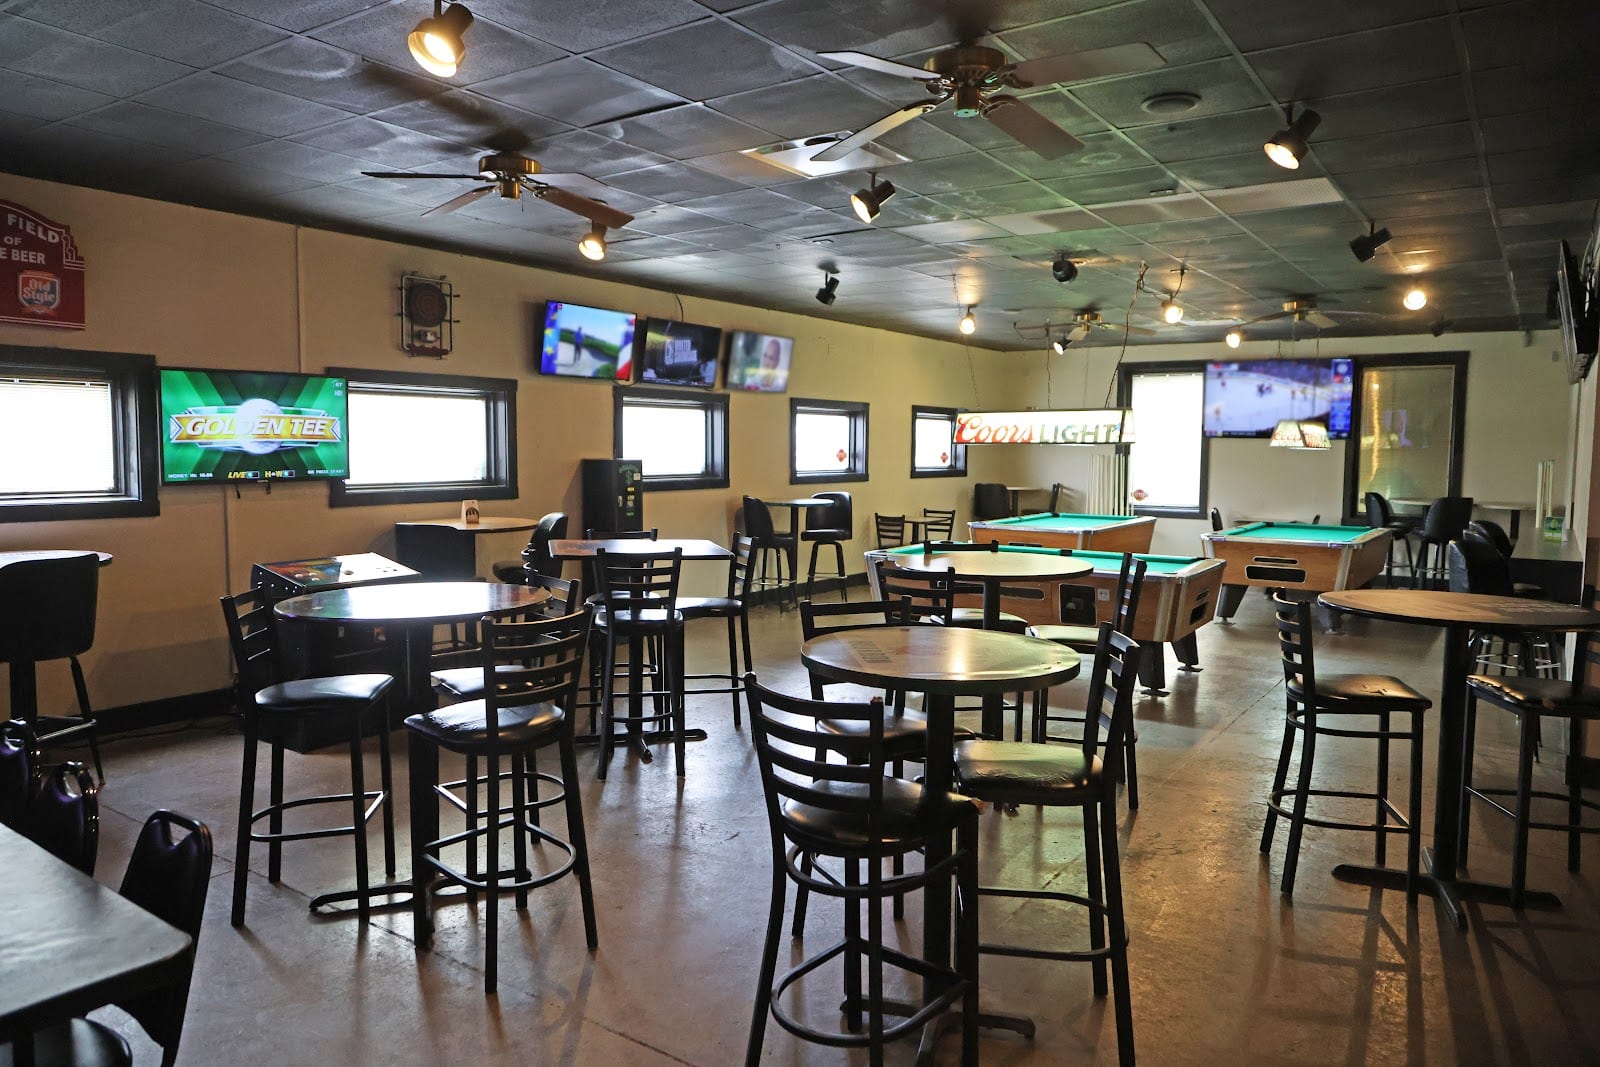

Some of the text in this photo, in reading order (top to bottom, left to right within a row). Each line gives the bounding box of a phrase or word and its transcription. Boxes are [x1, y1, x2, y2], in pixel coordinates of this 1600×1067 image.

[7, 213, 60, 243] FIELD
[4, 235, 22, 246] OF
[11, 248, 46, 265] BEER
[29, 279, 51, 292] Old
[23, 287, 55, 305] Style
[186, 417, 327, 436] GOLDEN TEE
[955, 415, 1117, 443] Coors LIGHT
[227, 471, 247, 479] LIVE
